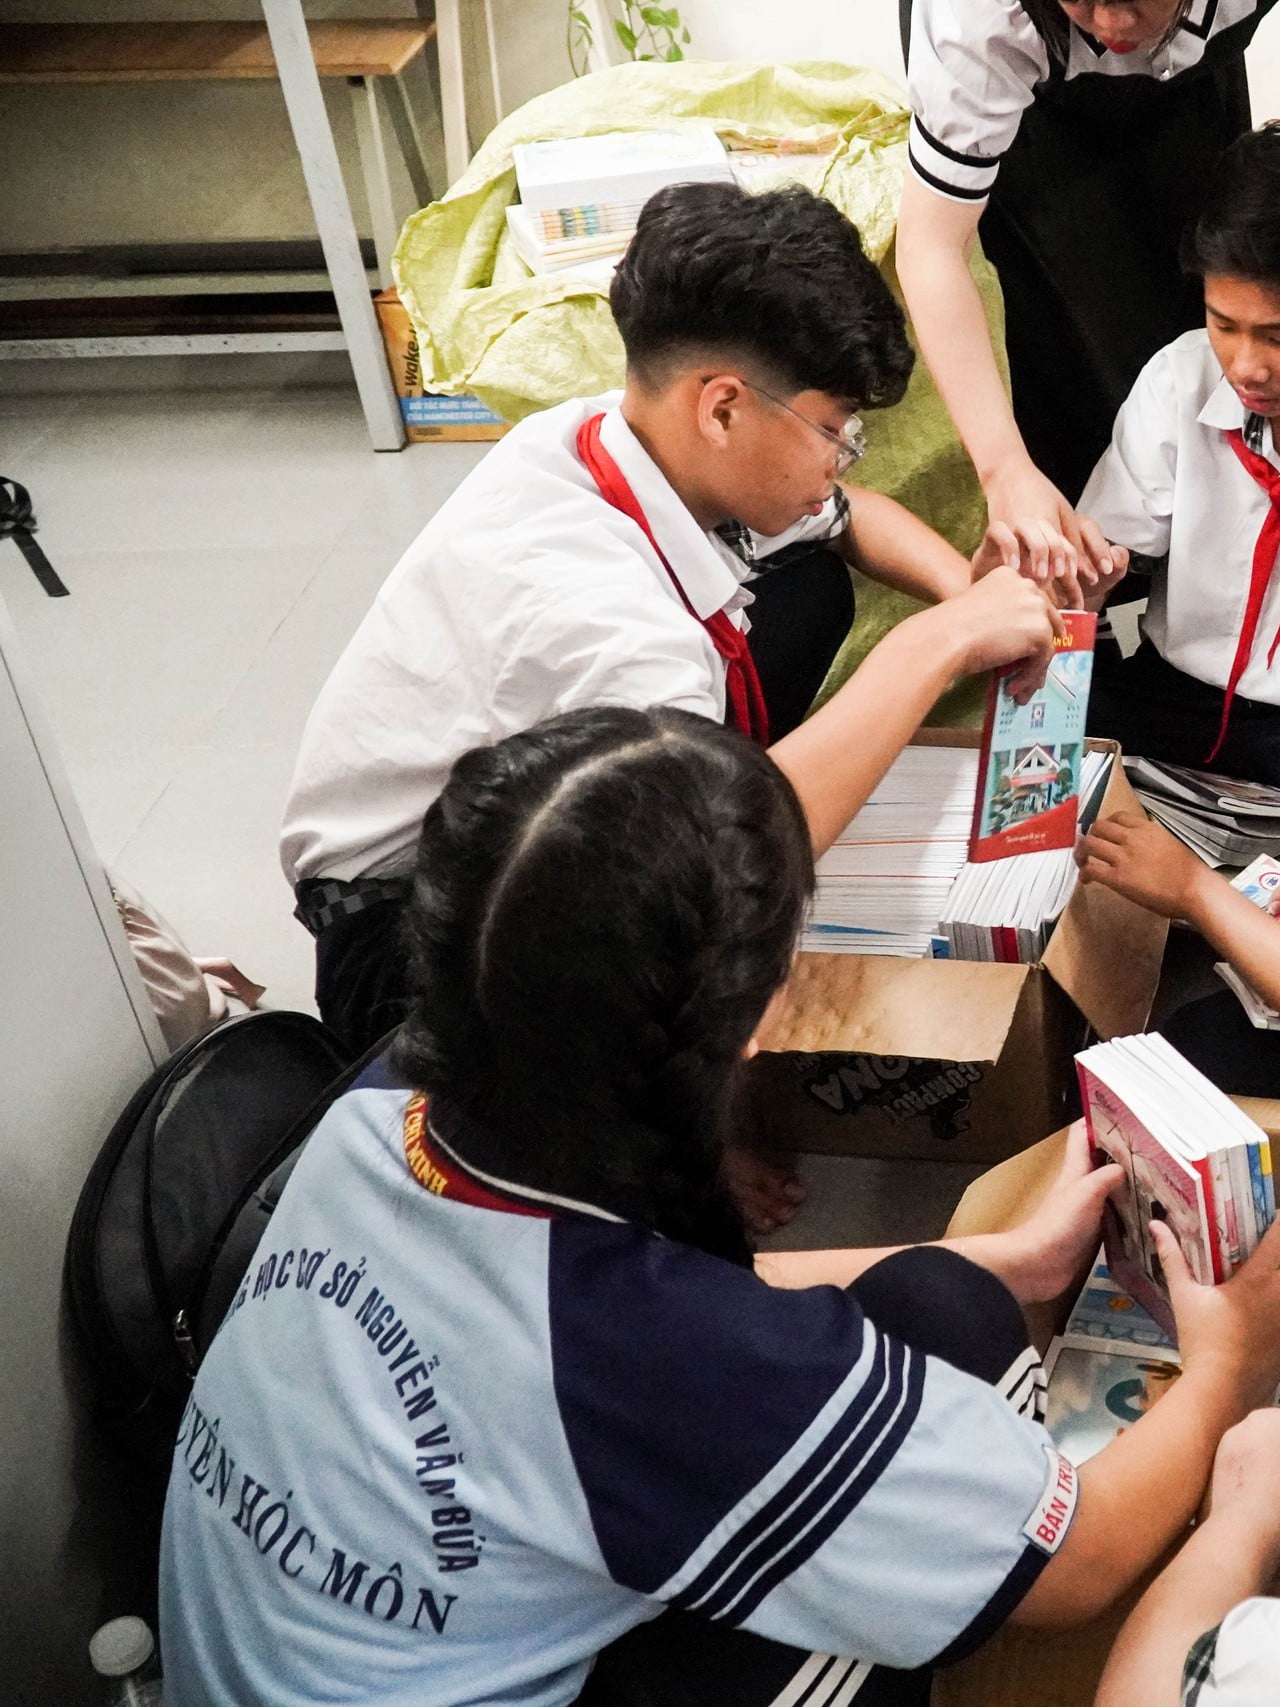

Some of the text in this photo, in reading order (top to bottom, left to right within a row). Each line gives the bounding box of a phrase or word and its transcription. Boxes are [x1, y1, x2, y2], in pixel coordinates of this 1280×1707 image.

[406, 1141, 448, 1196] MINH
[252, 1249, 295, 1301] HỌC
[319, 1256, 367, 1309] SỞ
[355, 1286, 440, 1422] NGUYỄN
[415, 1423, 465, 1500] VĂN
[431, 1505, 486, 1573] BỨA
[1036, 1496, 1068, 1545] BÁN
[232, 1474, 316, 1578] HÓC
[319, 1547, 458, 1635] MÔN
